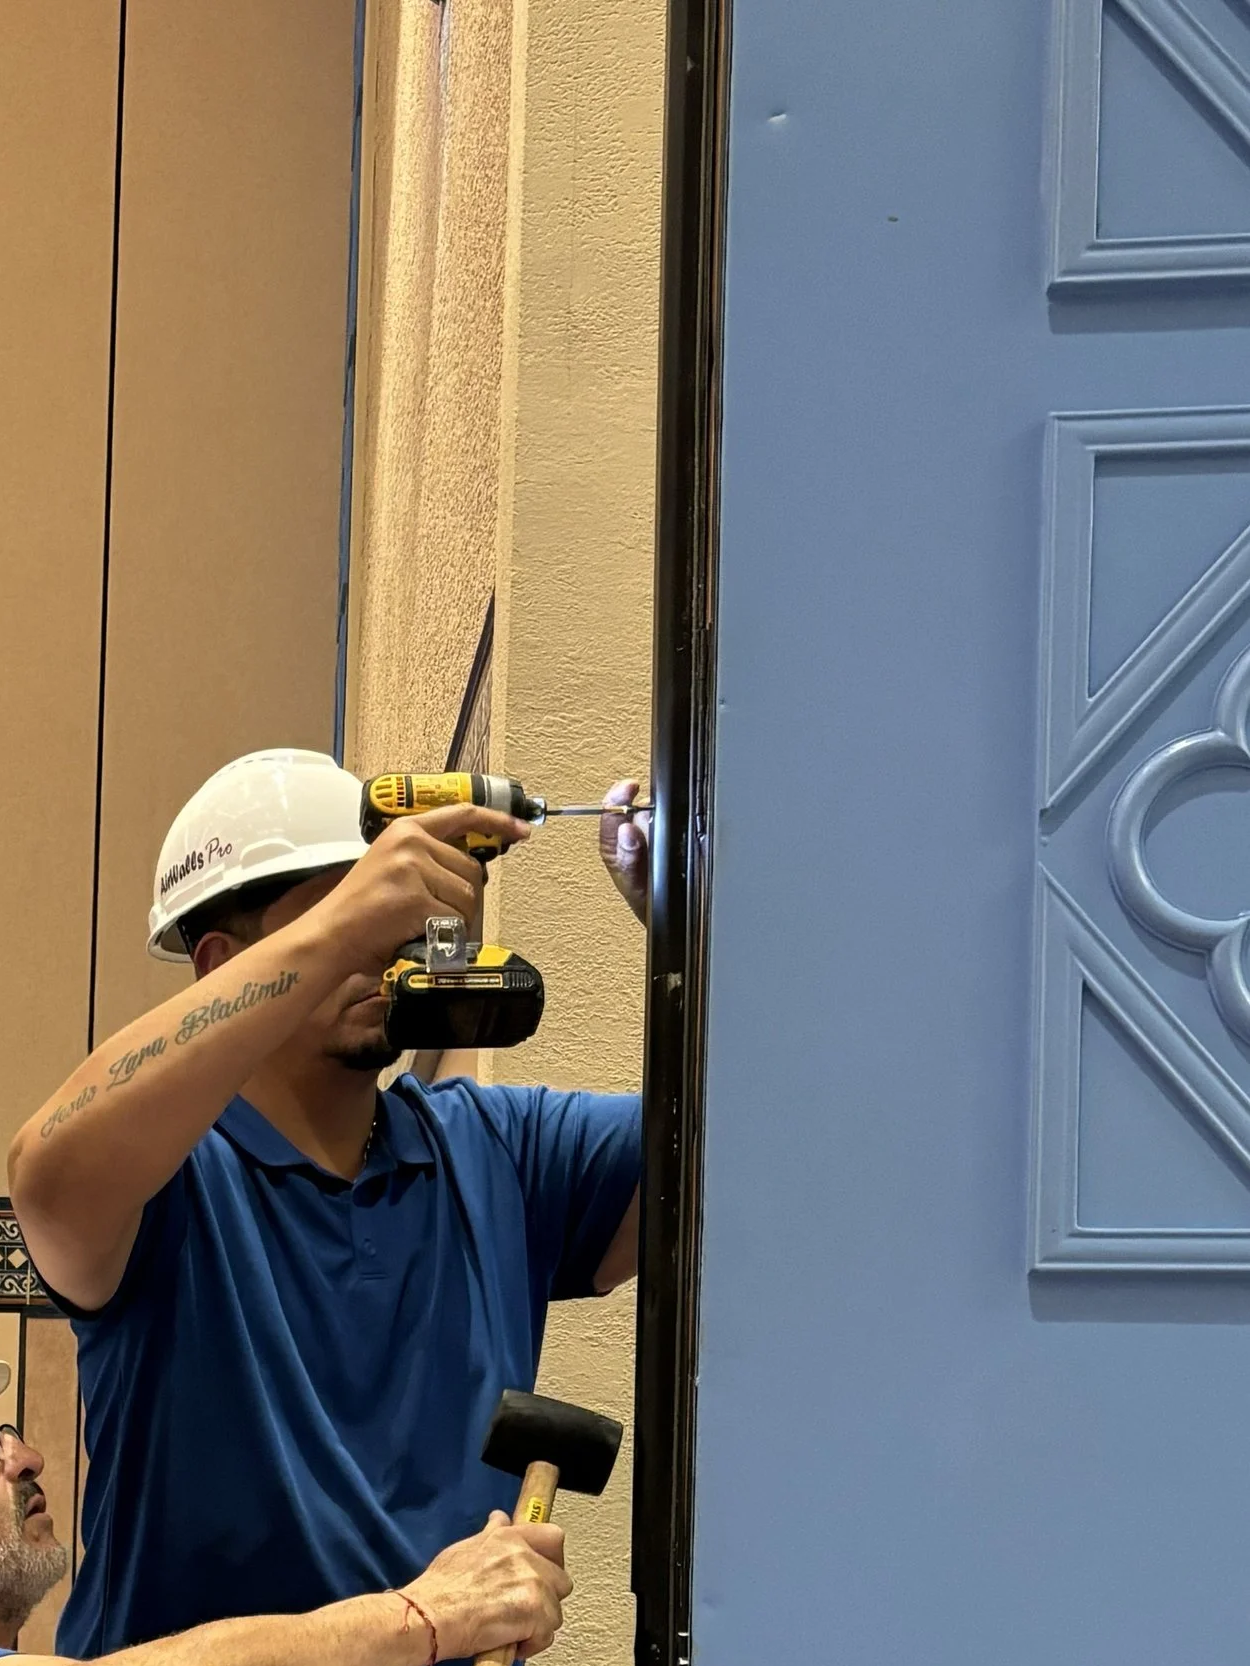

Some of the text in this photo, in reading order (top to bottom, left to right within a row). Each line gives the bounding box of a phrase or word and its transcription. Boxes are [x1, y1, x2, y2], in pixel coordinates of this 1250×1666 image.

[160, 837, 233, 896] AirWalls Pro
[175, 971, 301, 1045] Bladimir
